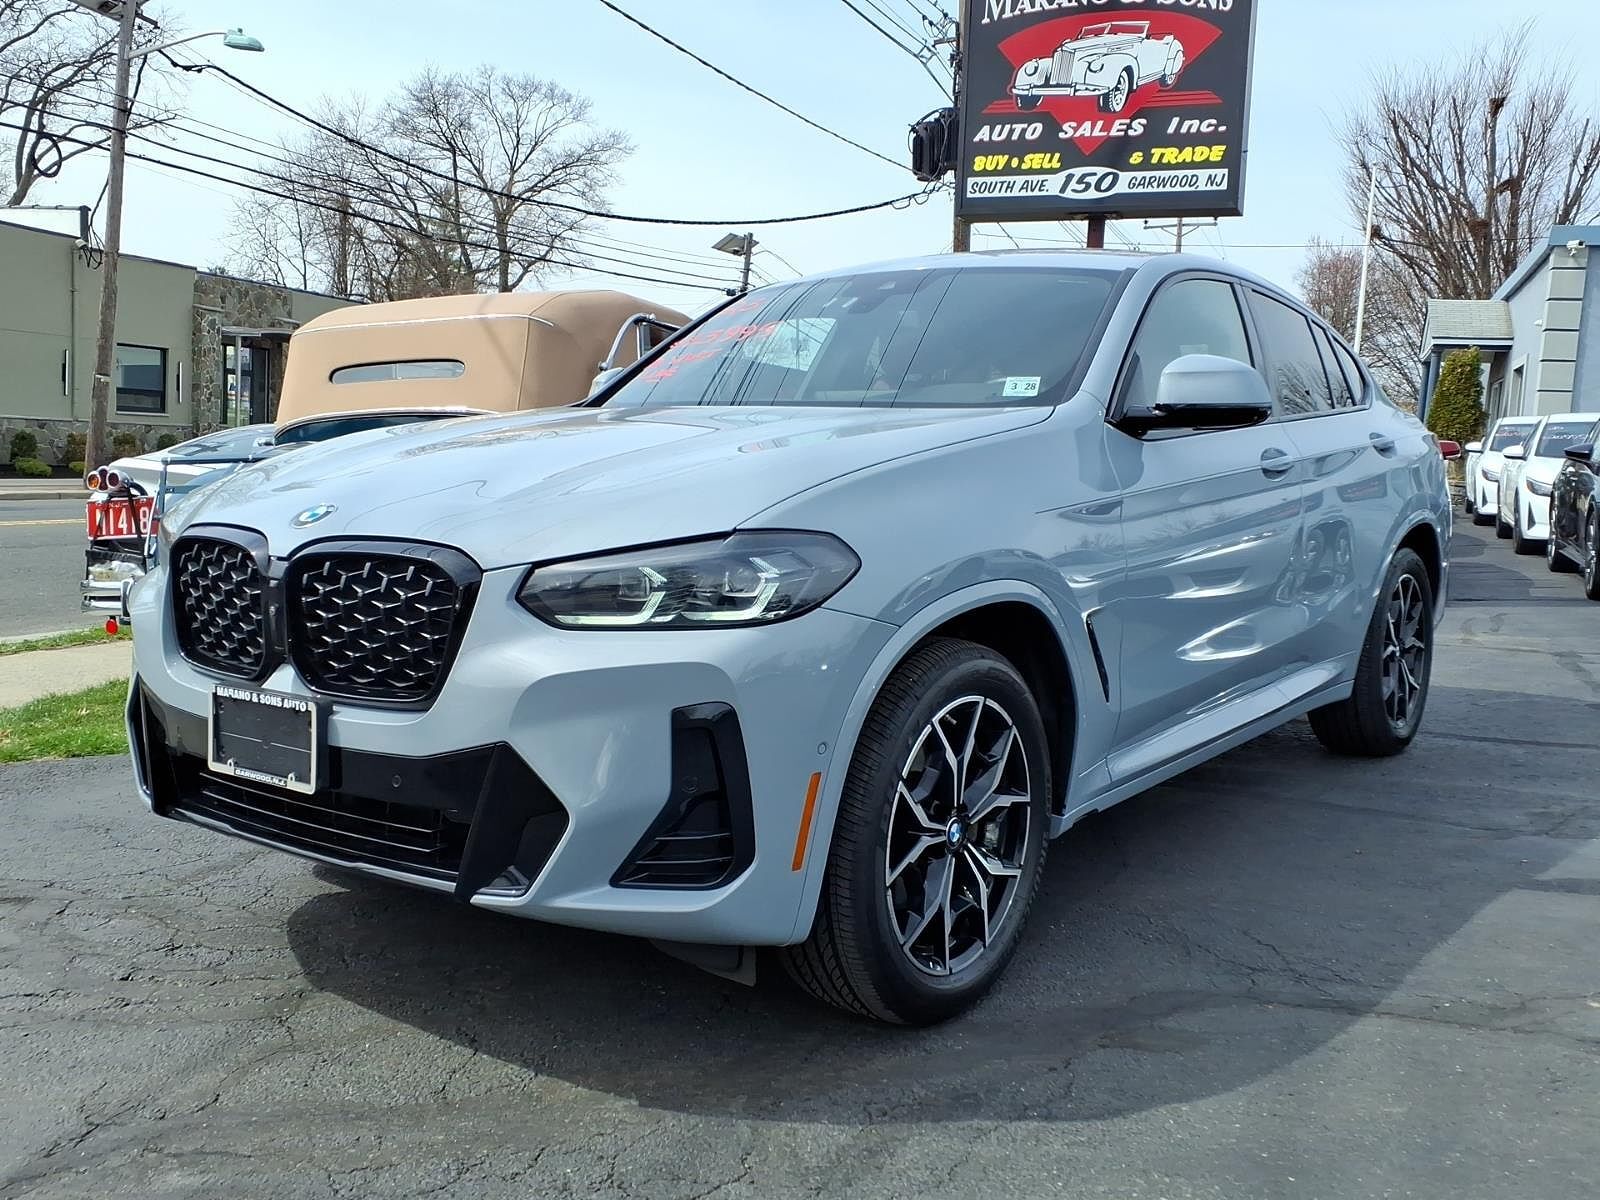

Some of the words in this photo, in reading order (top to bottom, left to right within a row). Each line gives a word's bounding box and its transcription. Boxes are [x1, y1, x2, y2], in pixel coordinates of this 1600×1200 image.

[981, 0, 1109, 24] MAR
[973, 122, 1043, 142] AUTO
[1058, 119, 1147, 139] SALES
[1167, 117, 1227, 134] Inc.
[973, 155, 1009, 172] BUY
[1021, 152, 1061, 169] SELL
[1129, 151, 1144, 164] &
[1150, 145, 1226, 164] TRADE
[969, 180, 1016, 194] SOUTH
[1018, 179, 1049, 193] AVE.
[1058, 171, 1120, 194] 150
[1127, 174, 1199, 190] GARWOOD,
[1205, 173, 1226, 187] NJ
[1024, 382, 1037, 391] 28
[252, 693, 259, 703] &
[259, 694, 282, 707] SONS
[283, 698, 307, 712] AUTO
